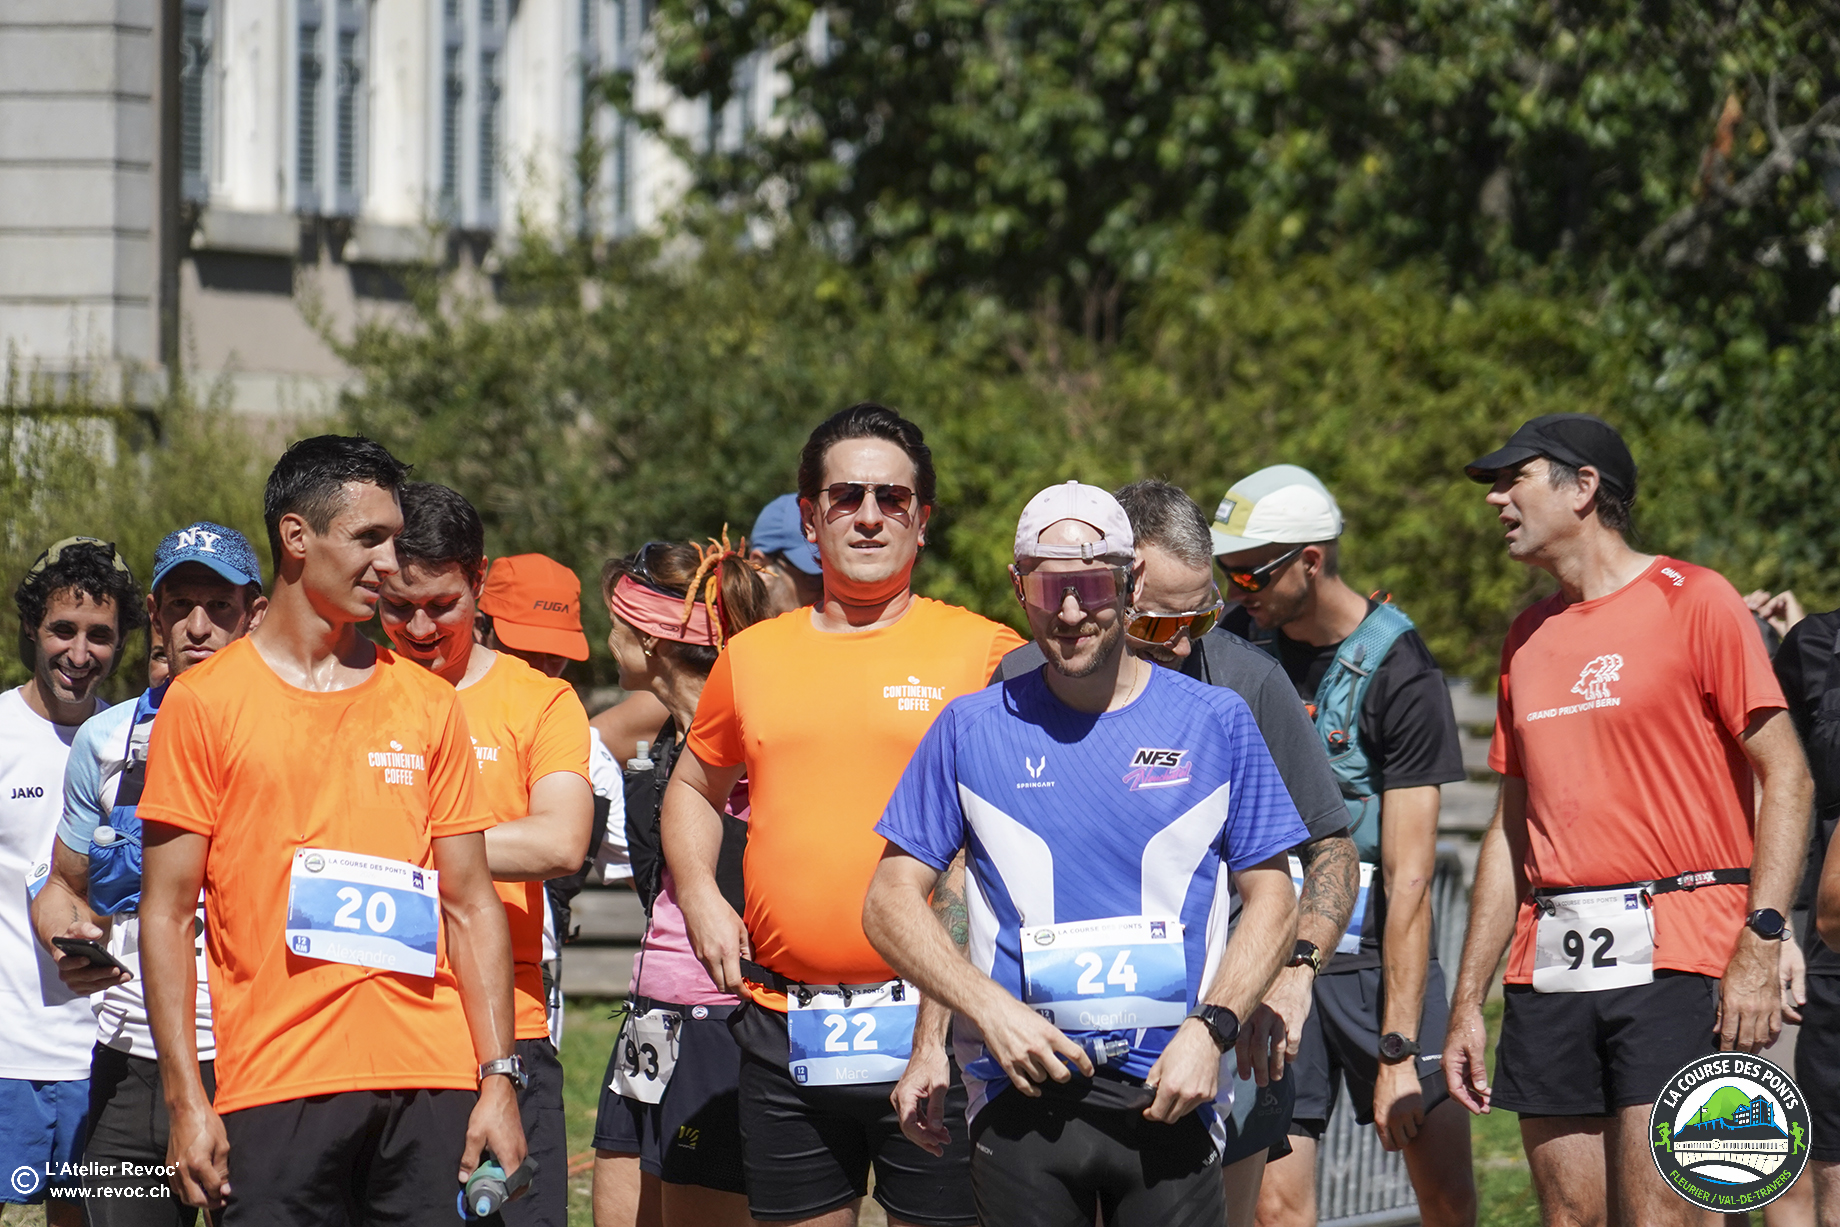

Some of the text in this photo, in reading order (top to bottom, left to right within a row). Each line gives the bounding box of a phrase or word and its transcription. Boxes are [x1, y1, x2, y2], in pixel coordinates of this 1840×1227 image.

[176, 527, 221, 553] NY
[533, 600, 569, 614] FUGA
[883, 685, 943, 700] CONTINENTAL
[898, 697, 930, 711] COFFEE
[1526, 697, 1621, 722] GRAND PRIX VON BERN
[368, 751, 425, 771] CONTINENTAL
[1134, 750, 1182, 767] NFS
[384, 768, 414, 786] COFFEE
[1016, 781, 1055, 789] SPRINGART
[11, 786, 44, 799] JAKO
[340, 859, 367, 869] COURSE
[369, 863, 383, 871] DES
[384, 866, 407, 875] PONTS
[334, 886, 397, 934] 20
[295, 943, 308, 952] KM
[296, 936, 306, 945] 12
[1563, 927, 1618, 971] 92
[325, 942, 396, 966] Alexandre
[1074, 950, 1138, 994] 24
[1040, 1009, 1049, 1017] 12
[1079, 1009, 1137, 1026] Quentin
[823, 1012, 878, 1052] 22
[625, 1042, 659, 1082] 93
[797, 1066, 805, 1074] 12
[835, 1067, 869, 1080] Marc
